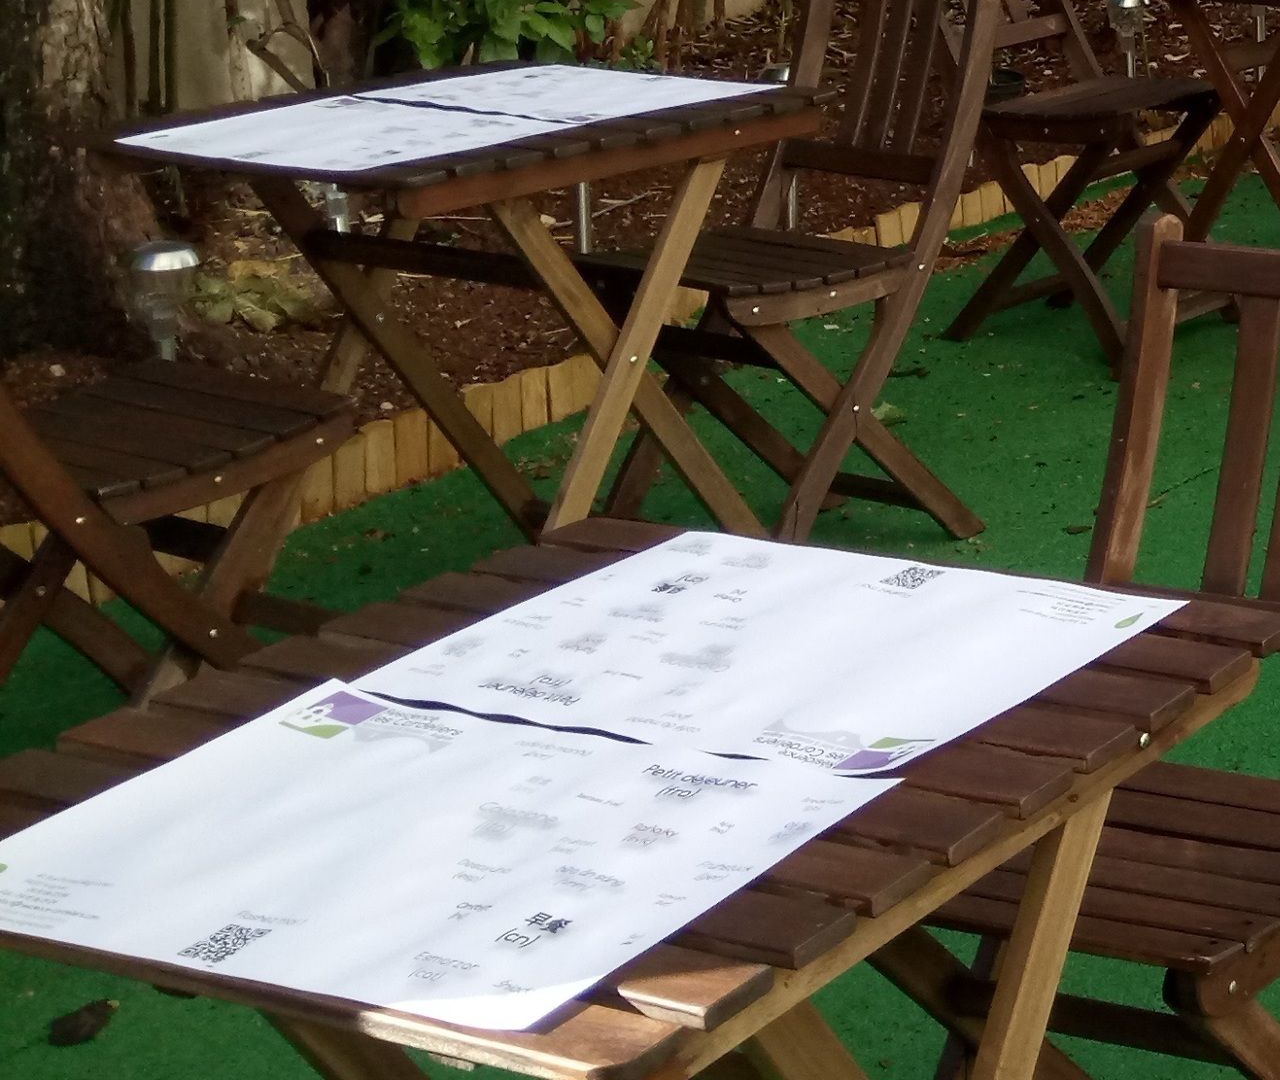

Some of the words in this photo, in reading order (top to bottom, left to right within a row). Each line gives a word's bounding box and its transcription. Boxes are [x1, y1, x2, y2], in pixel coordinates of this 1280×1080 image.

[544, 691, 581, 707] Petit
[642, 764, 683, 780] Petit
[495, 927, 543, 949] (cn)
